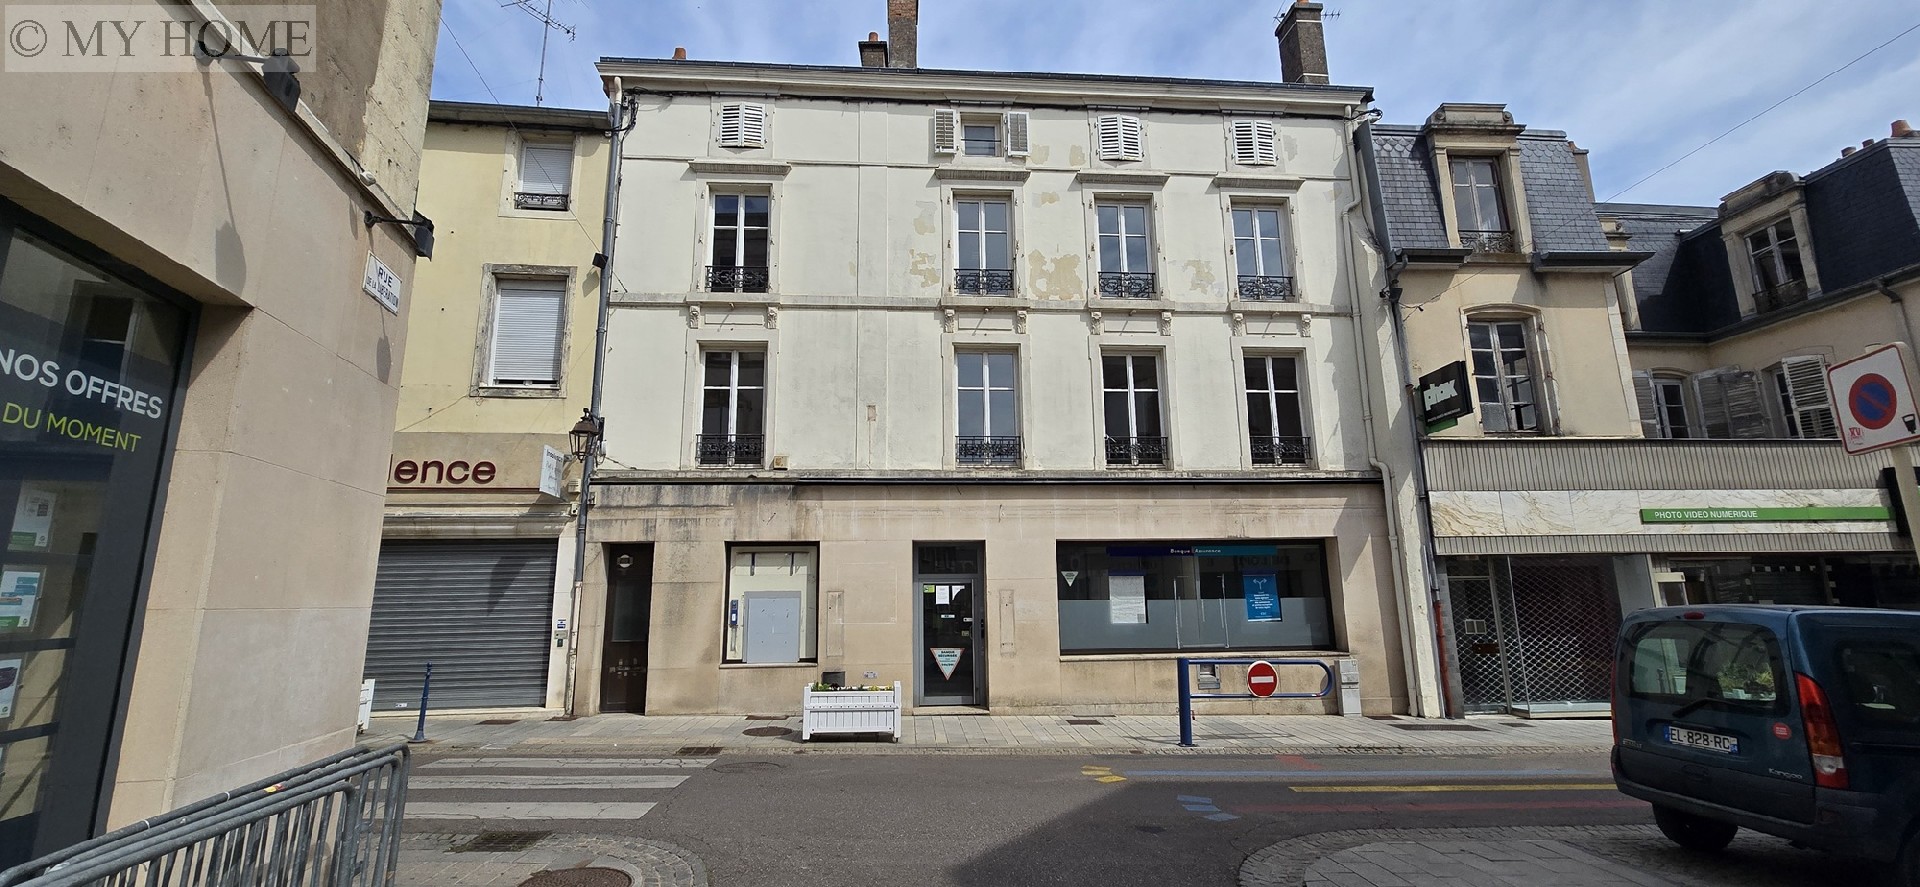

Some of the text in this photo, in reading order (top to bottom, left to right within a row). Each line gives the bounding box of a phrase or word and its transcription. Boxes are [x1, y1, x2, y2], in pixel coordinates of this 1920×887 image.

[378, 266, 393, 288] RUE
[0, 349, 163, 419] NOS OFFRES
[2, 402, 142, 452] DU MOMENT
[1654, 510, 1758, 519] PHOTO VIDEO NUMERIQUE
[1670, 728, 1730, 750] EL-828-RC
[1768, 767, 1802, 780] Kangoo
